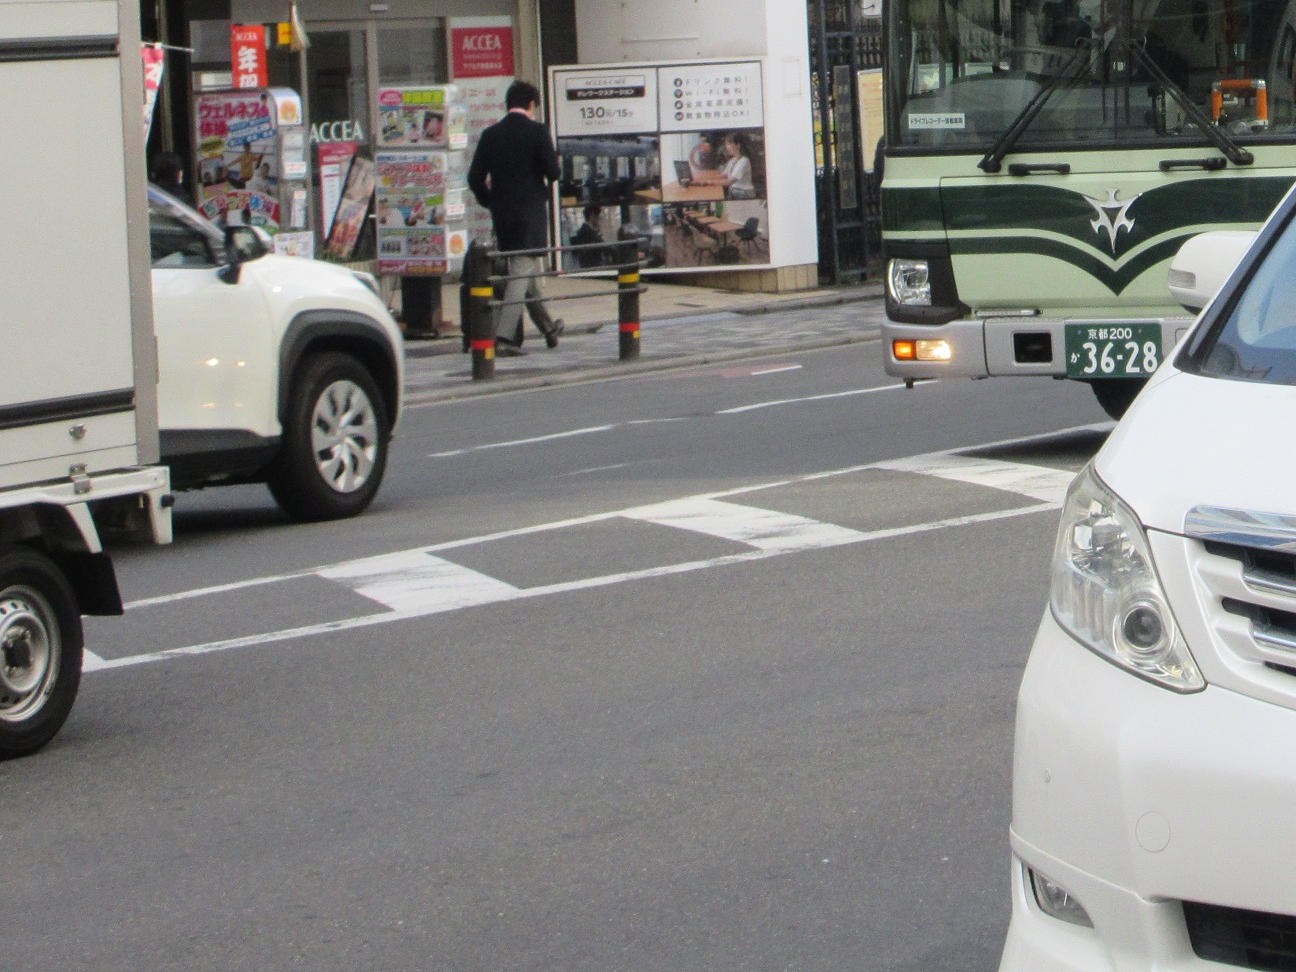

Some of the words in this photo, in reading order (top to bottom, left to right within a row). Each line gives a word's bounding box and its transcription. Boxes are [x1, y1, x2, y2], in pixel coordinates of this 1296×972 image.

[462, 35, 501, 51] ACCEA
[310, 121, 363, 143] ACCEA
[1088, 328, 1132, 339] 京都200
[1071, 353, 1080, 363] か
[1082, 341, 1158, 373] 36-28
